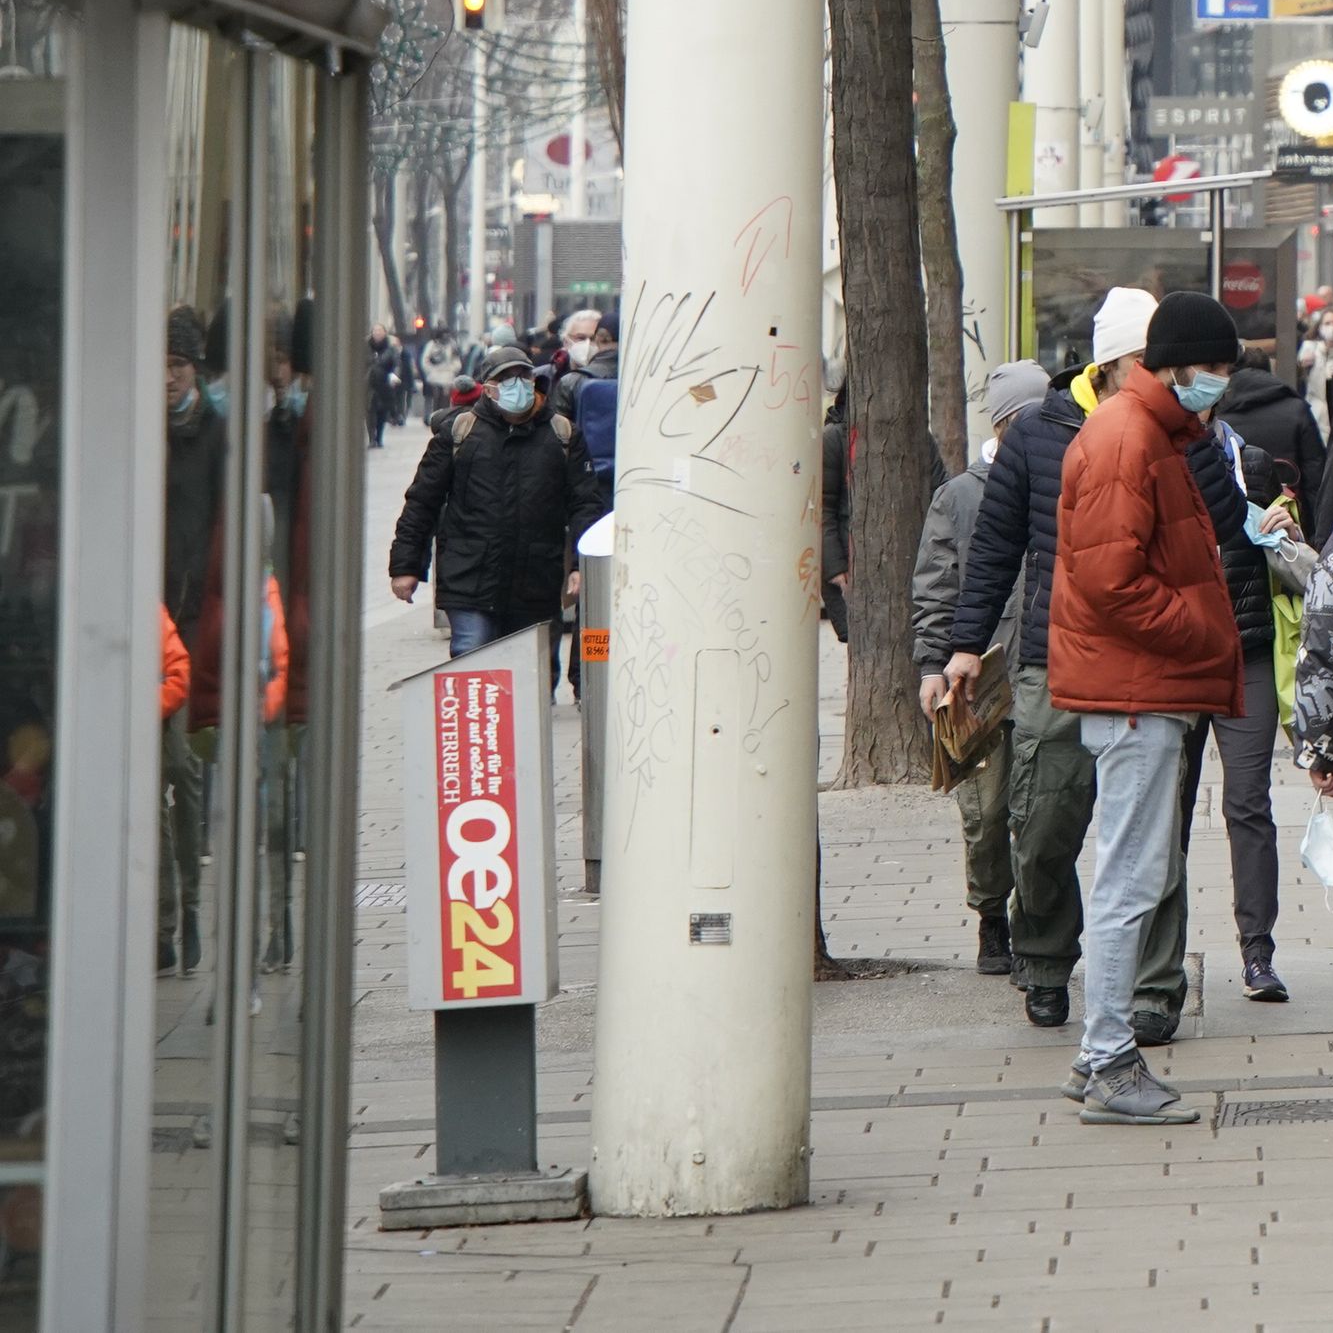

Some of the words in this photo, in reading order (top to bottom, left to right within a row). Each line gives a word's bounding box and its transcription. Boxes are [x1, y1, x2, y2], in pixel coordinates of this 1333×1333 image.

[1155, 107, 1248, 127] ESPRIT
[466, 678, 482, 720] Handy
[485, 683, 499, 705] Als
[469, 722, 483, 745] auf
[484, 706, 500, 753] ePaper
[441, 696, 461, 804] ÖSTERREICH
[488, 754, 502, 775] für
[470, 746, 485, 796] oe24.at
[488, 776, 502, 795] Ihr
[446, 799, 515, 999] oe24
